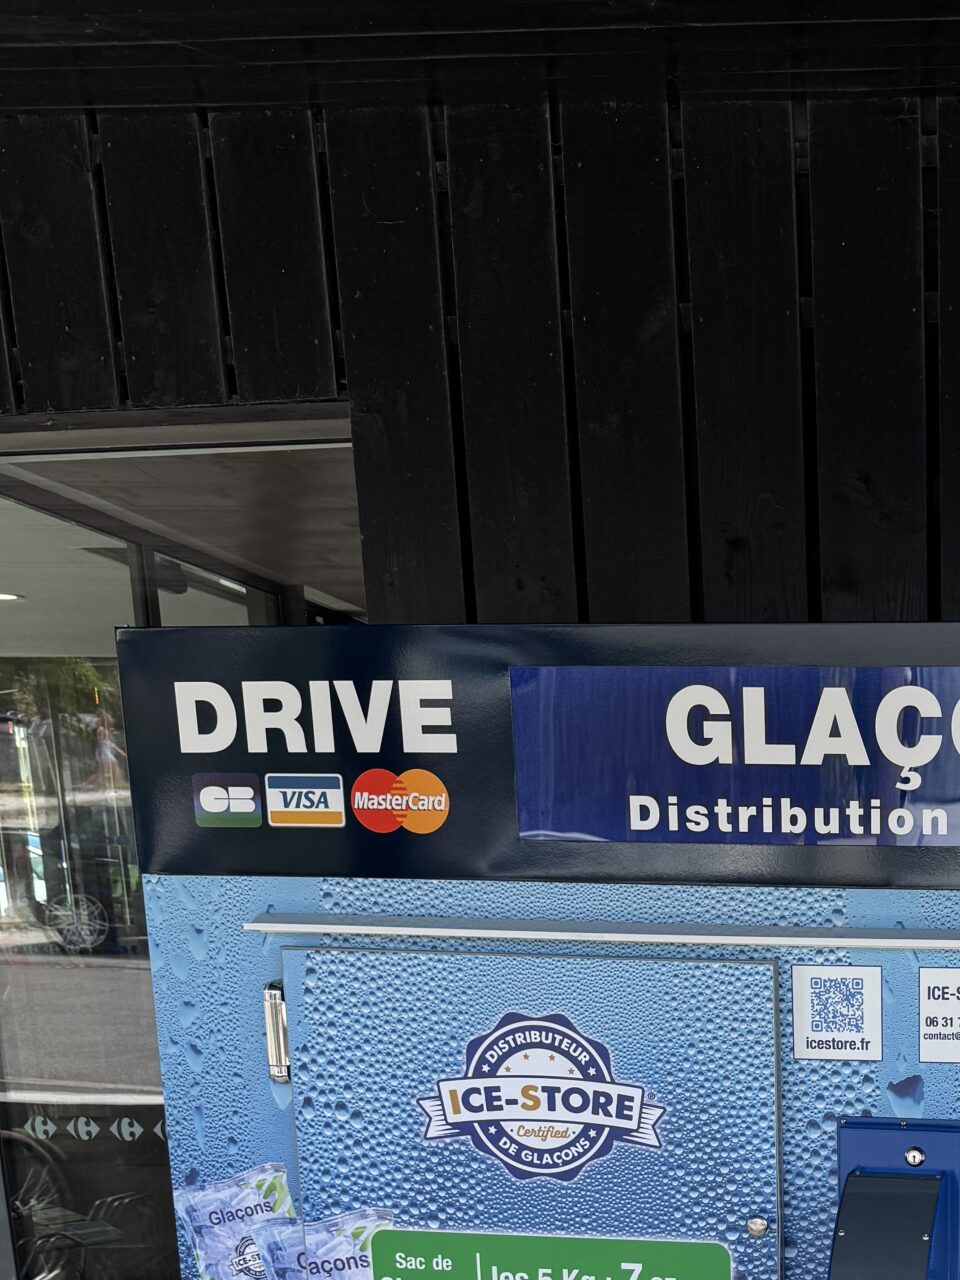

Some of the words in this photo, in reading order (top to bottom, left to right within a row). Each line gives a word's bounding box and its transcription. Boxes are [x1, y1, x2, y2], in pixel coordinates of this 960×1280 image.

[174, 679, 458, 753] DRIVE
[280, 789, 330, 811] VISA
[354, 791, 448, 812] MasterCard
[629, 794, 949, 836] Distribution
[925, 1016, 938, 1027] 06
[942, 1017, 954, 1027] 31
[485, 1031, 590, 1066] DISTRIBUTEUR
[806, 1037, 870, 1051] icestore.fr
[449, 1084, 635, 1121] ICE-STORE
[517, 1125, 570, 1141] Certified
[498, 1137, 518, 1154] DE
[521, 1138, 590, 1166] GLAÇONS
[209, 1201, 272, 1226] Glaçons
[396, 1252, 425, 1270] Sac
[432, 1255, 452, 1270] de
